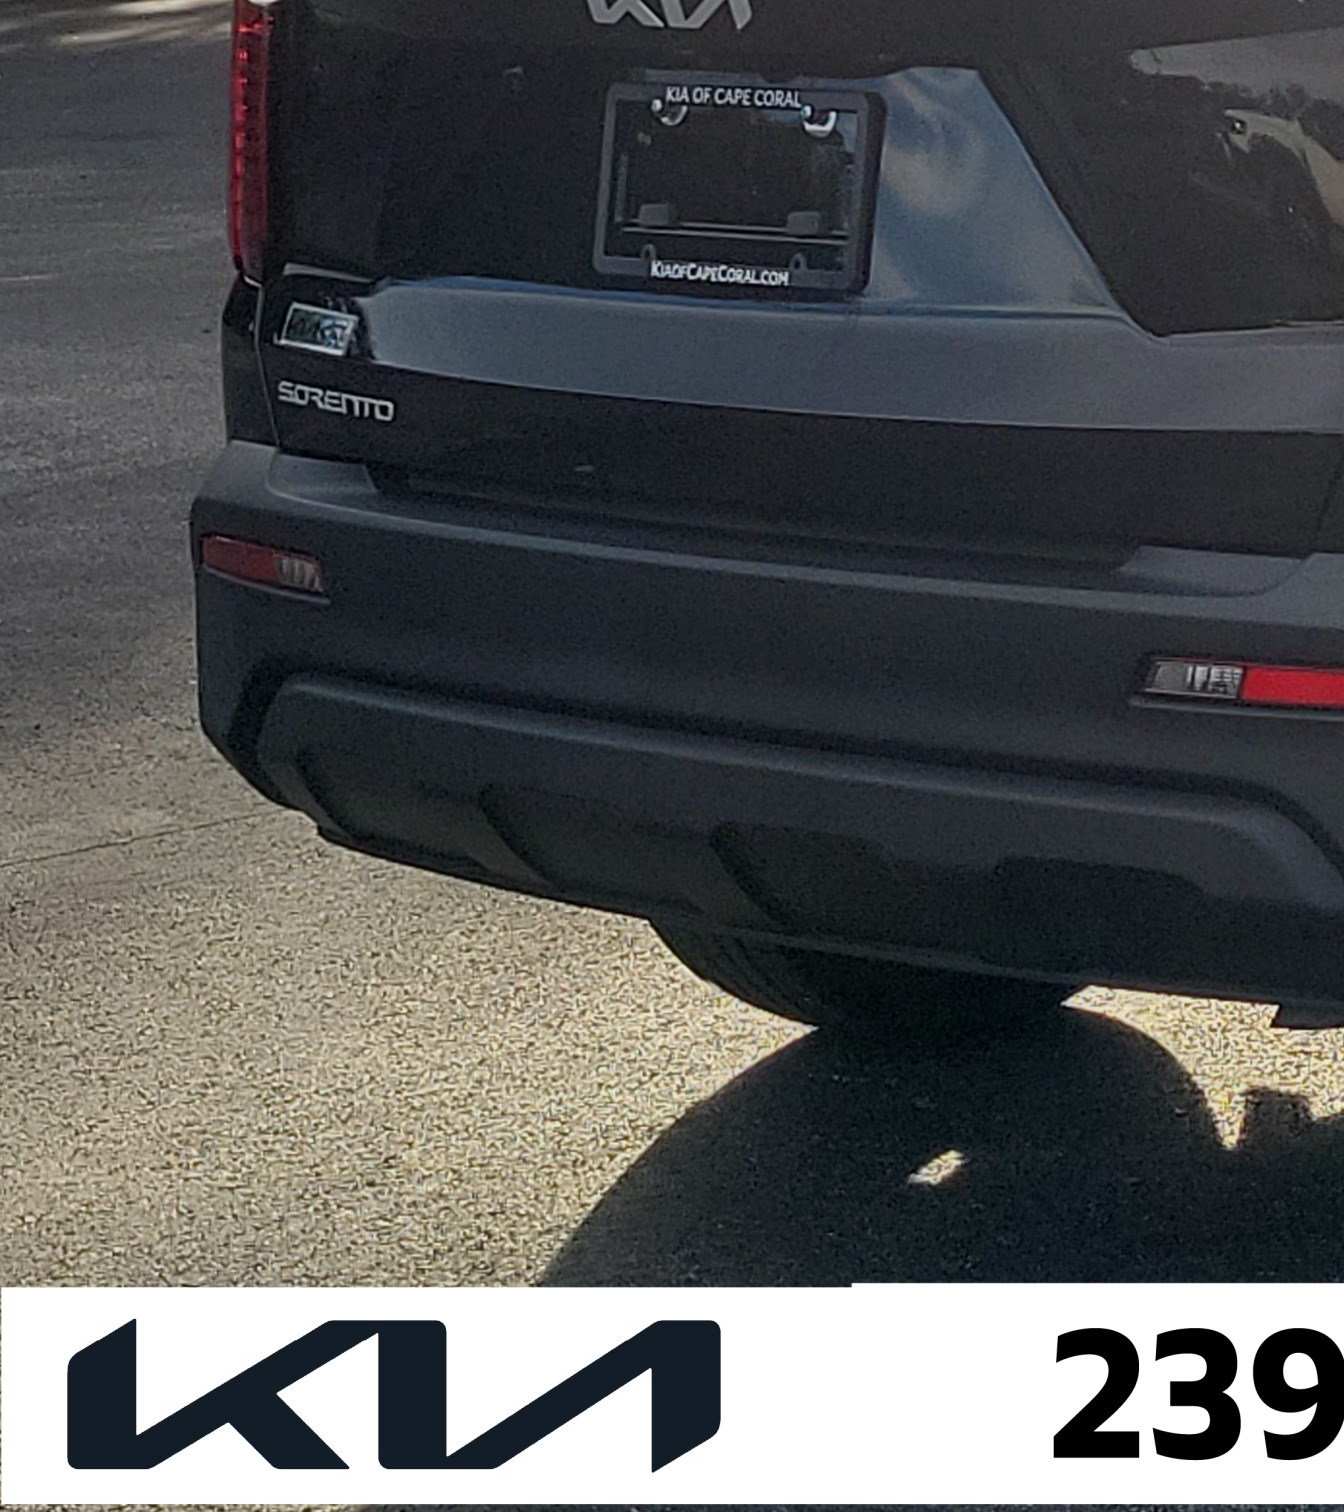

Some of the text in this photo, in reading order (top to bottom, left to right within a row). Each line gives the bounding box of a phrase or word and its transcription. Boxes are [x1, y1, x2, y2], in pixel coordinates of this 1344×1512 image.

[665, 86, 802, 108] KIA OF CAPE CORAL
[278, 380, 395, 422] SORENTO
